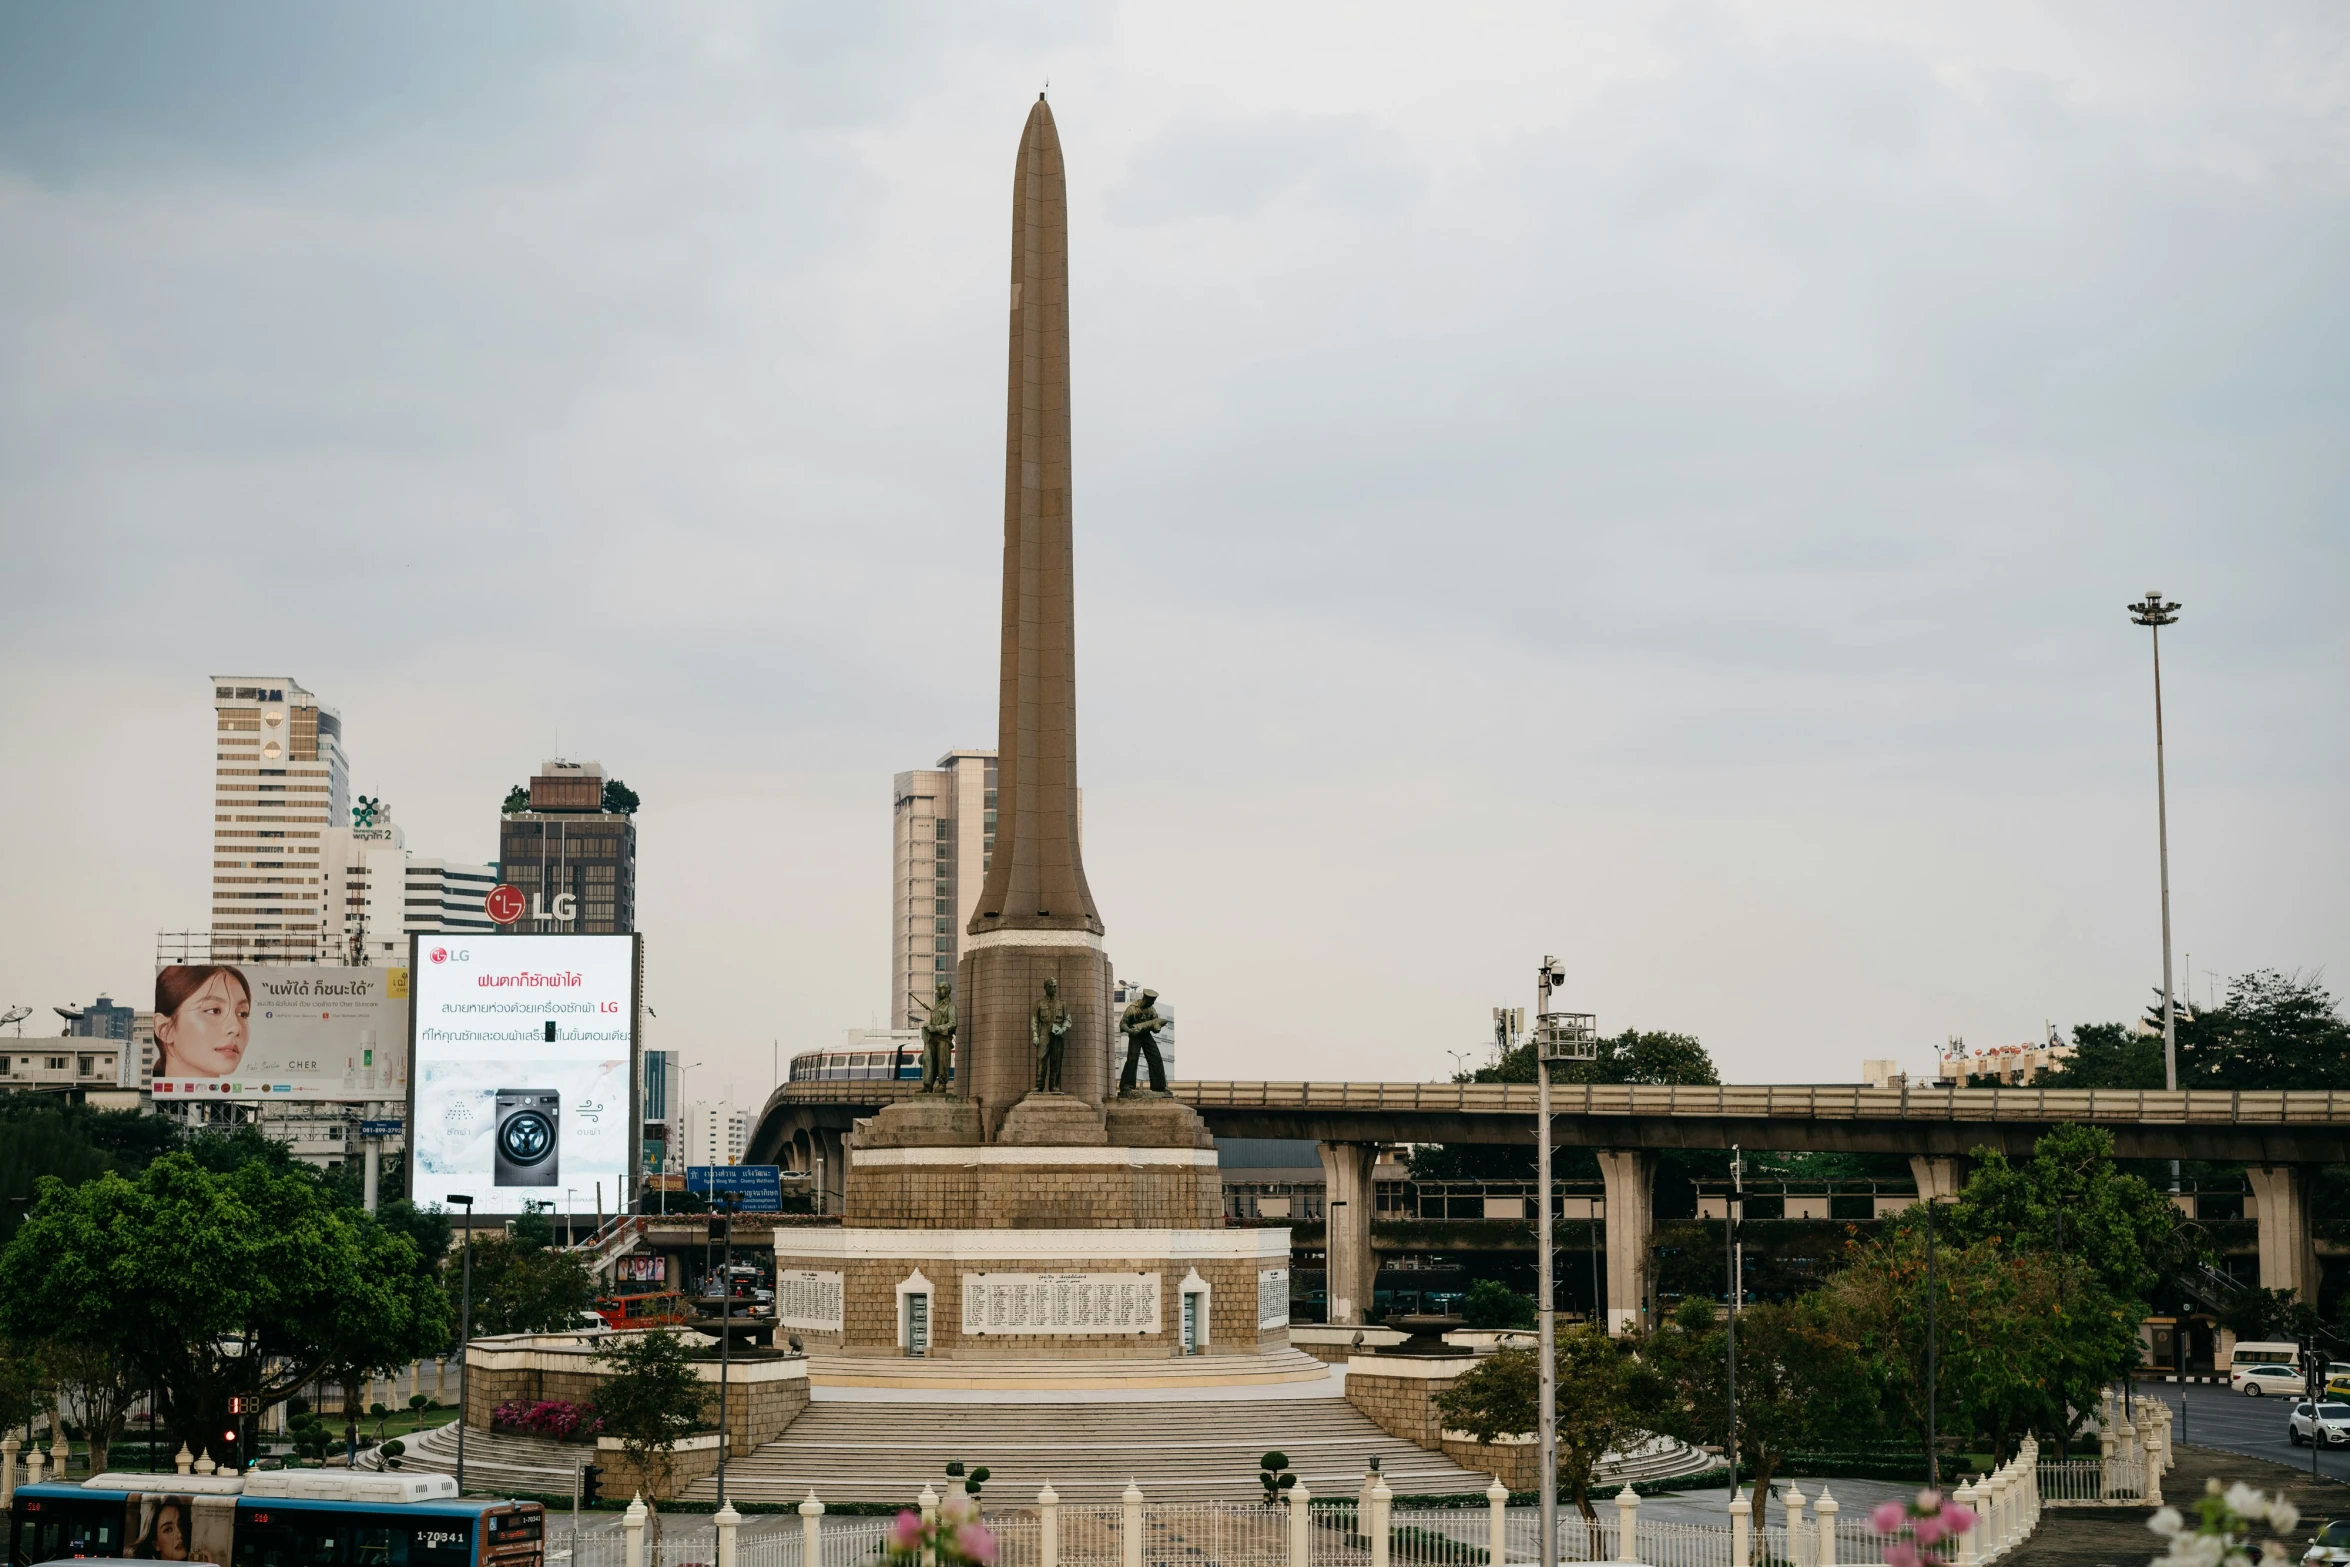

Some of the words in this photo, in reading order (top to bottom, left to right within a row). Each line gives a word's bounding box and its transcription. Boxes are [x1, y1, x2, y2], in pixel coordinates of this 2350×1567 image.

[384, 829, 392, 840] 2
[533, 892, 577, 921] LG
[450, 949, 470, 962] LG
[478, 971, 583, 988] ฝนตกก็ซักผ้าได้
[441, 1000, 595, 1014] สบายหายห่วงด้วยเครื่องซักผ้า
[600, 1001, 618, 1014] LG
[288, 1060, 317, 1069] CHER
[27, 1502, 41, 1511] 510
[253, 1513, 269, 1523] 510
[523, 1515, 541, 1523] 1-70341
[417, 1531, 464, 1542] 1-70341
